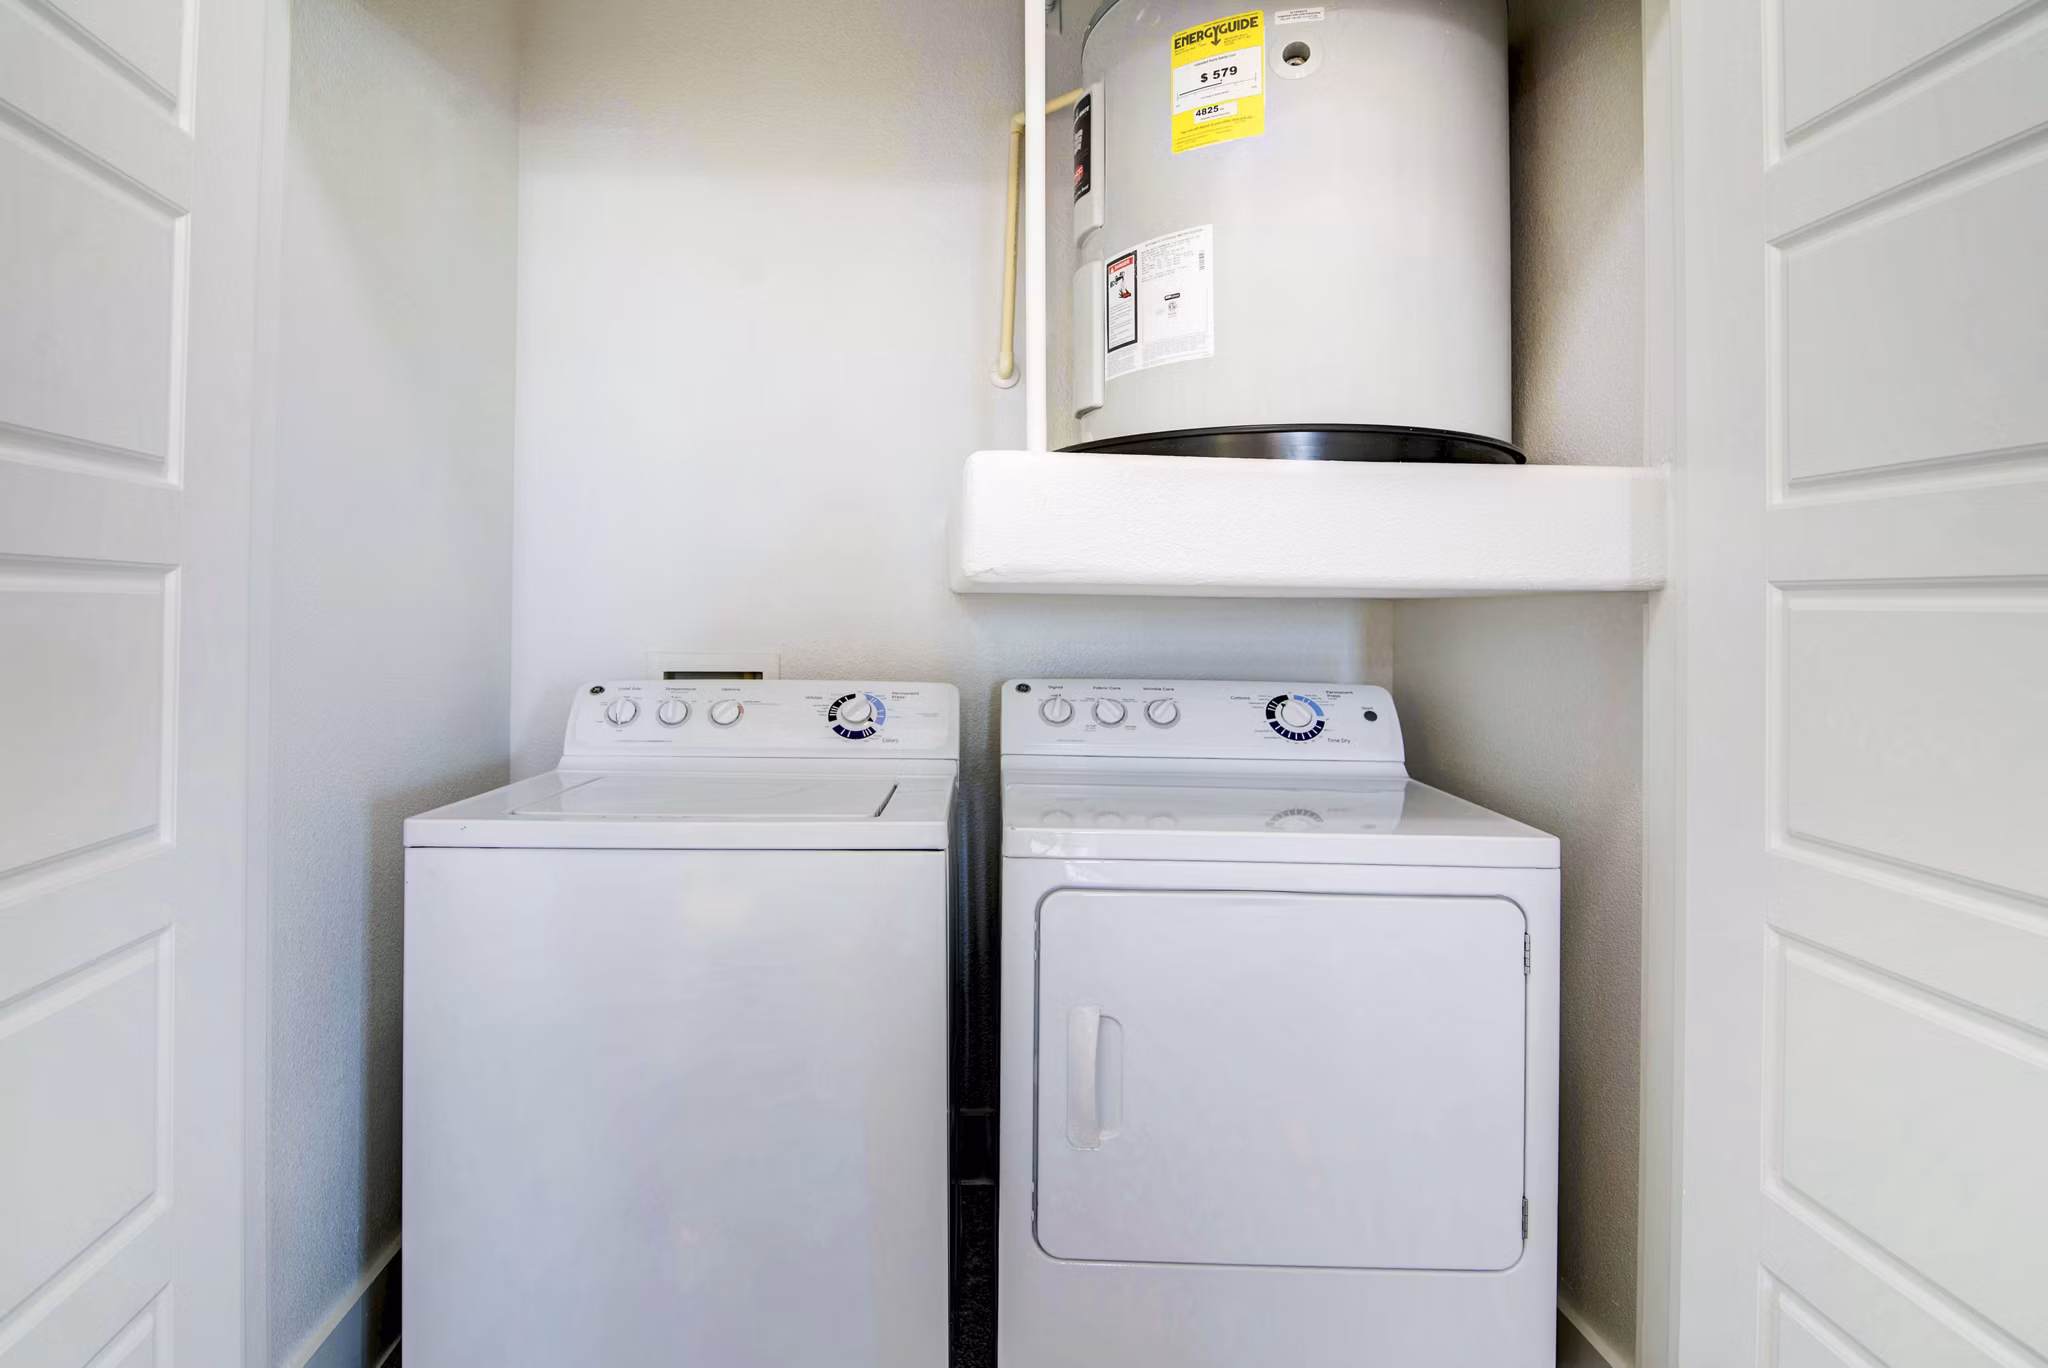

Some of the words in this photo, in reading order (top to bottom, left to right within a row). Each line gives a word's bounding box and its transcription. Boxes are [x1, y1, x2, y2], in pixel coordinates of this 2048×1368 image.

[1174, 15, 1259, 50] ENERGYGUIDE
[1200, 72, 1209, 83] $
[1212, 65, 1238, 80] 579
[1195, 104, 1219, 117] 4825
